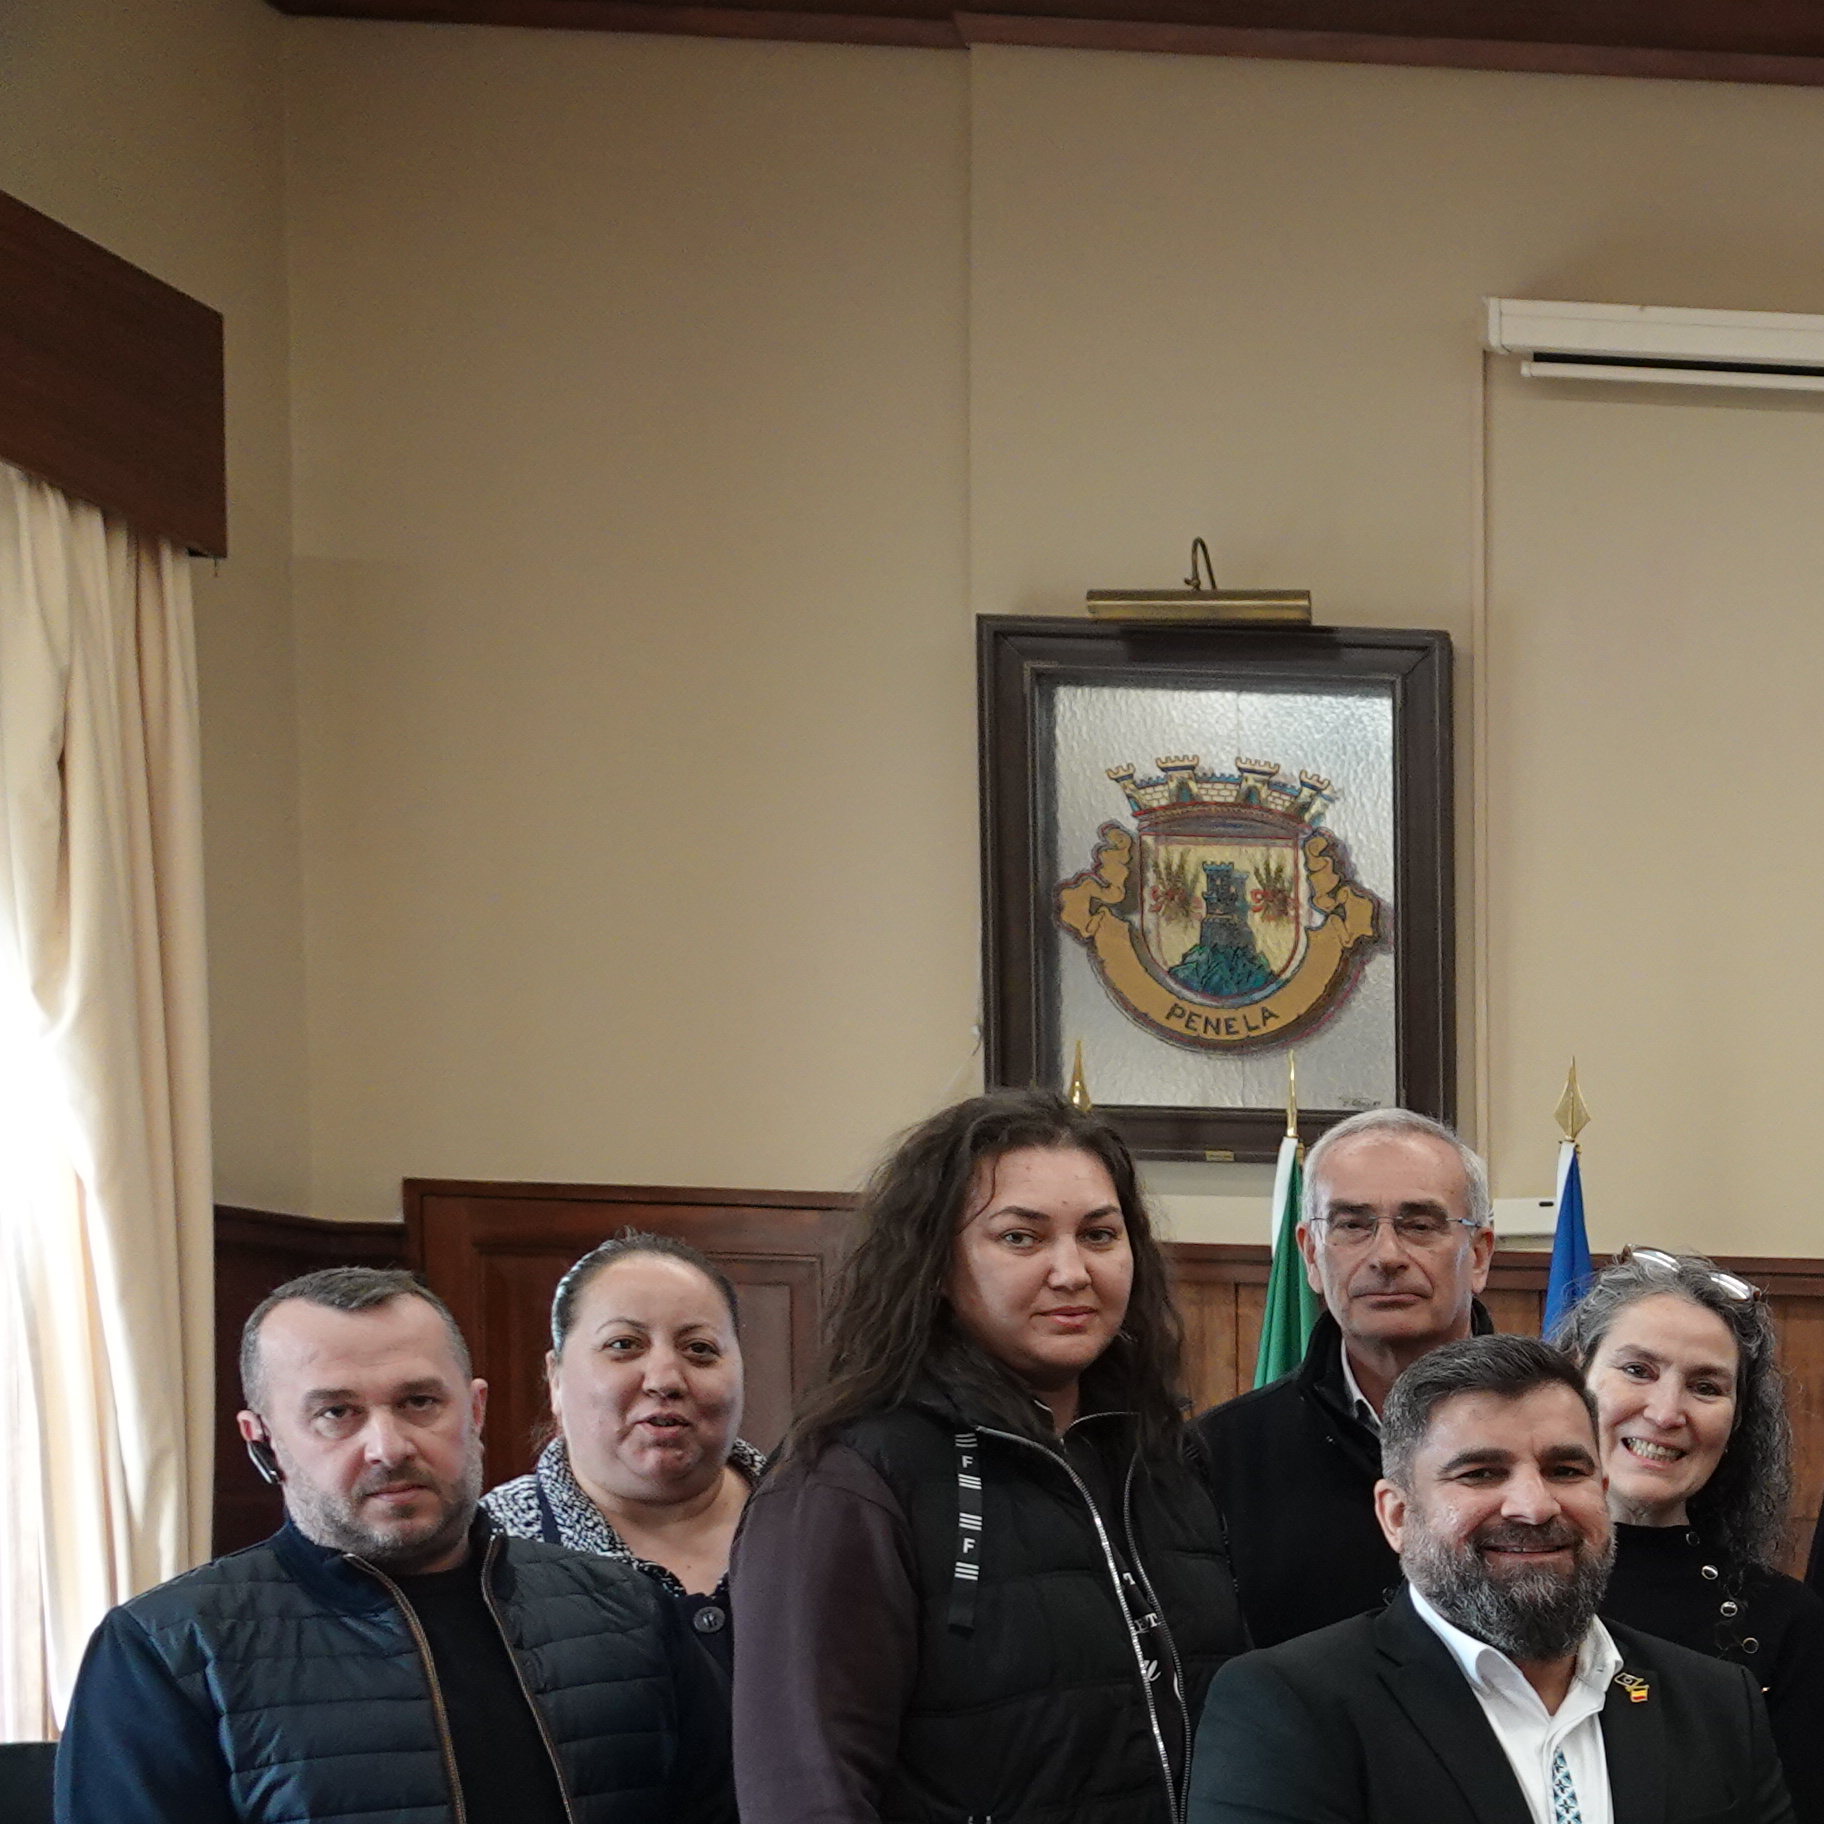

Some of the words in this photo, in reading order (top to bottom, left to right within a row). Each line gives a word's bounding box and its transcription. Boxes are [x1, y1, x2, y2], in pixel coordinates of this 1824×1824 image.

[1165, 1003, 1280, 1036] PENELA
[961, 1455, 973, 1468] F
[962, 1537, 976, 1554] F
